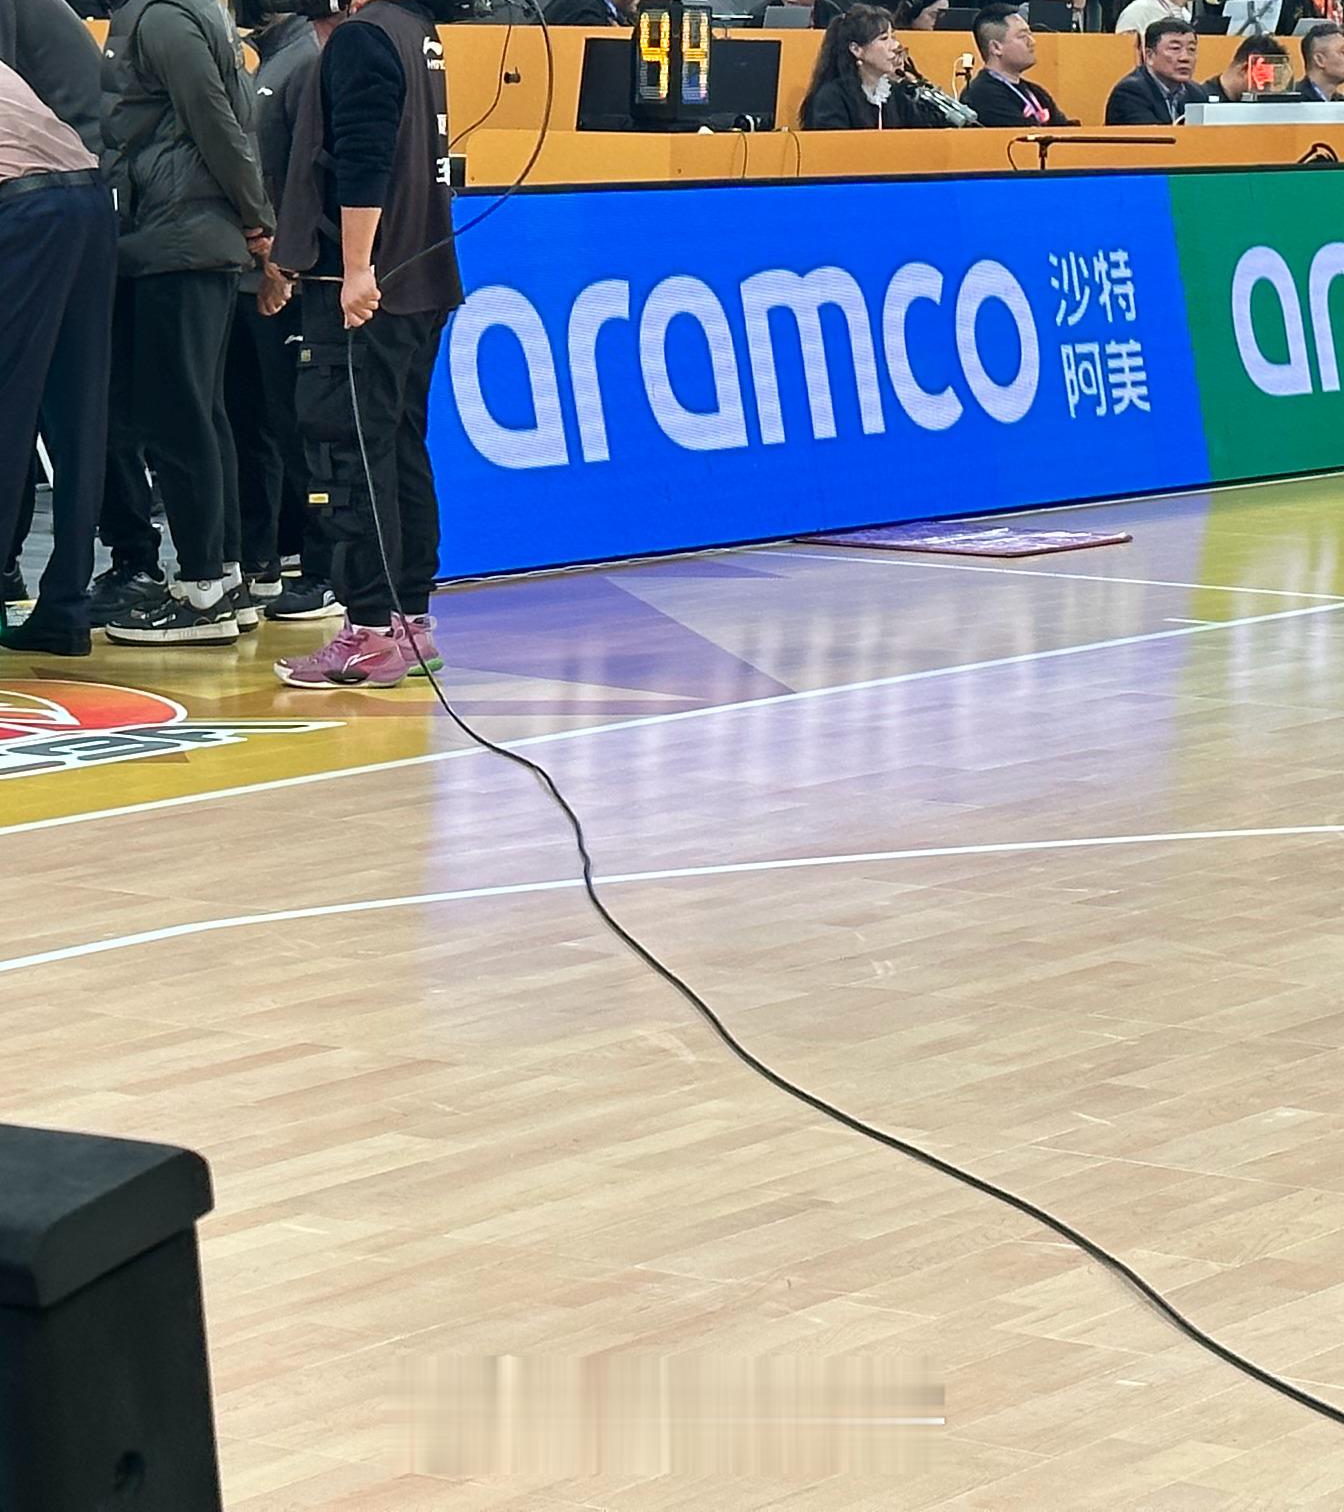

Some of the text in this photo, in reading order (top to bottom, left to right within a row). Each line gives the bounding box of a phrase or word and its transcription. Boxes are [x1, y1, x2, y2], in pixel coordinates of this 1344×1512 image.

[1048, 248, 1138, 329] 沙特
[448, 259, 1041, 470] aramco
[1059, 338, 1151, 418] 阿美
